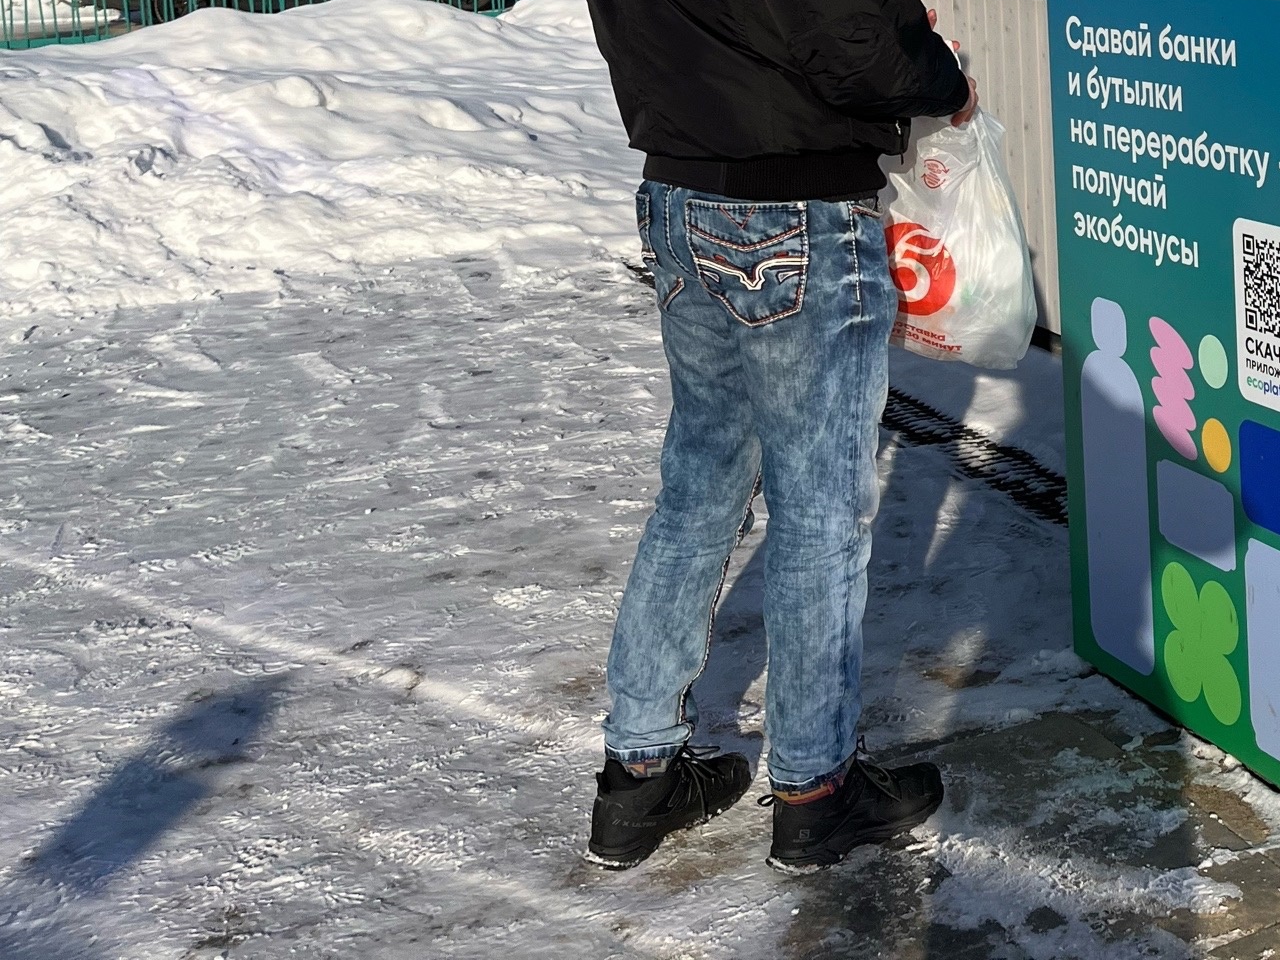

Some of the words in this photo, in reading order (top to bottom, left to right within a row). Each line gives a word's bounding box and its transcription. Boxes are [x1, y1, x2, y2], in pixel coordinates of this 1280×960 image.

[1065, 15, 1152, 58] Сдавай
[1158, 24, 1237, 67] банки
[1068, 71, 1081, 97] и
[1086, 65, 1183, 112] бутылки
[1070, 118, 1097, 147] на
[1103, 123, 1270, 188] переработку
[1072, 164, 1167, 210] получай
[1073, 211, 1199, 268] экобонусы
[906, 331, 920, 340] 30
[922, 337, 963, 352] минут
